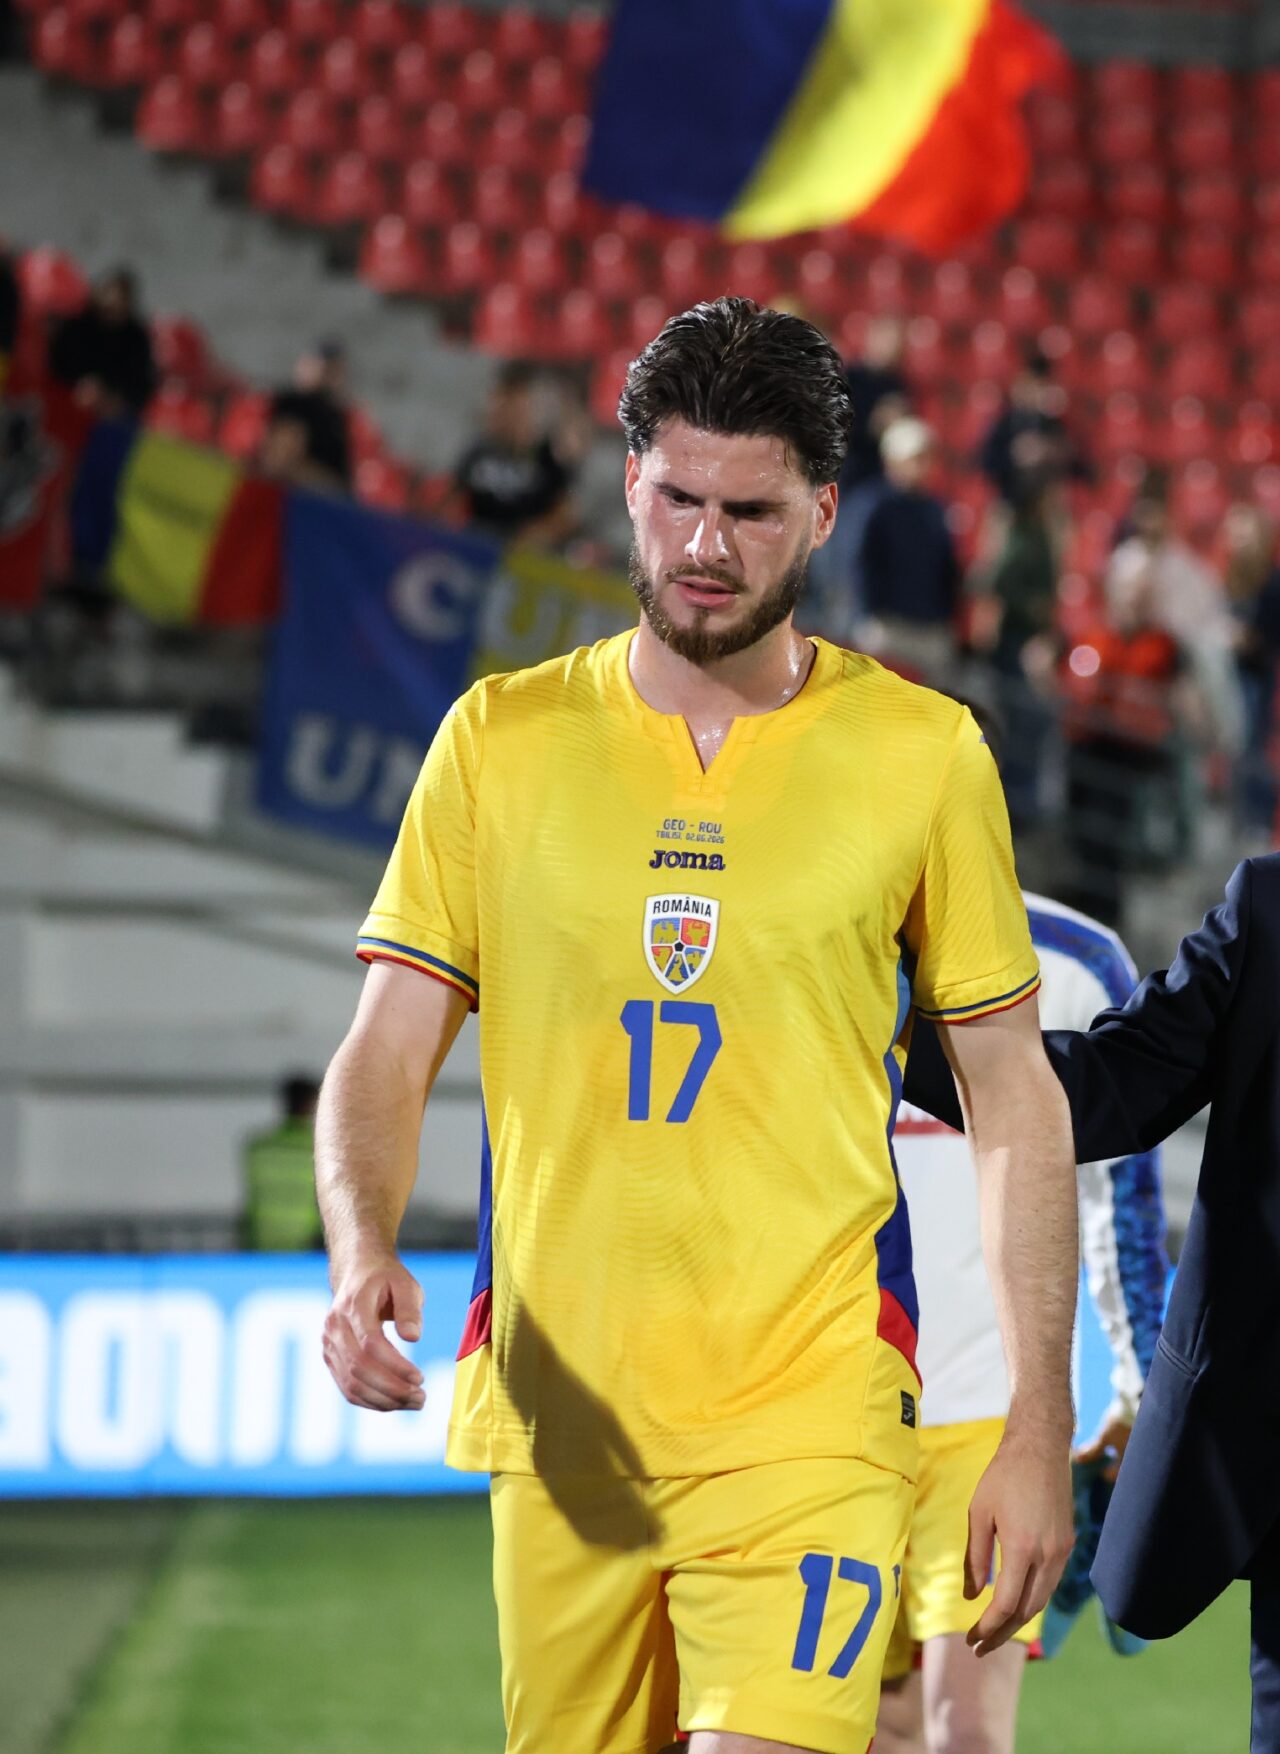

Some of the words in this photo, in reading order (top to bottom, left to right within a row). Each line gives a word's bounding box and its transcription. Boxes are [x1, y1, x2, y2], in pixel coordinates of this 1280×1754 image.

[663, 819, 686, 831] GEO
[699, 822, 722, 834] ROU
[653, 896, 712, 917] ROMÂNIA
[620, 1000, 722, 1123] 17
[791, 1553, 882, 1679] 17
